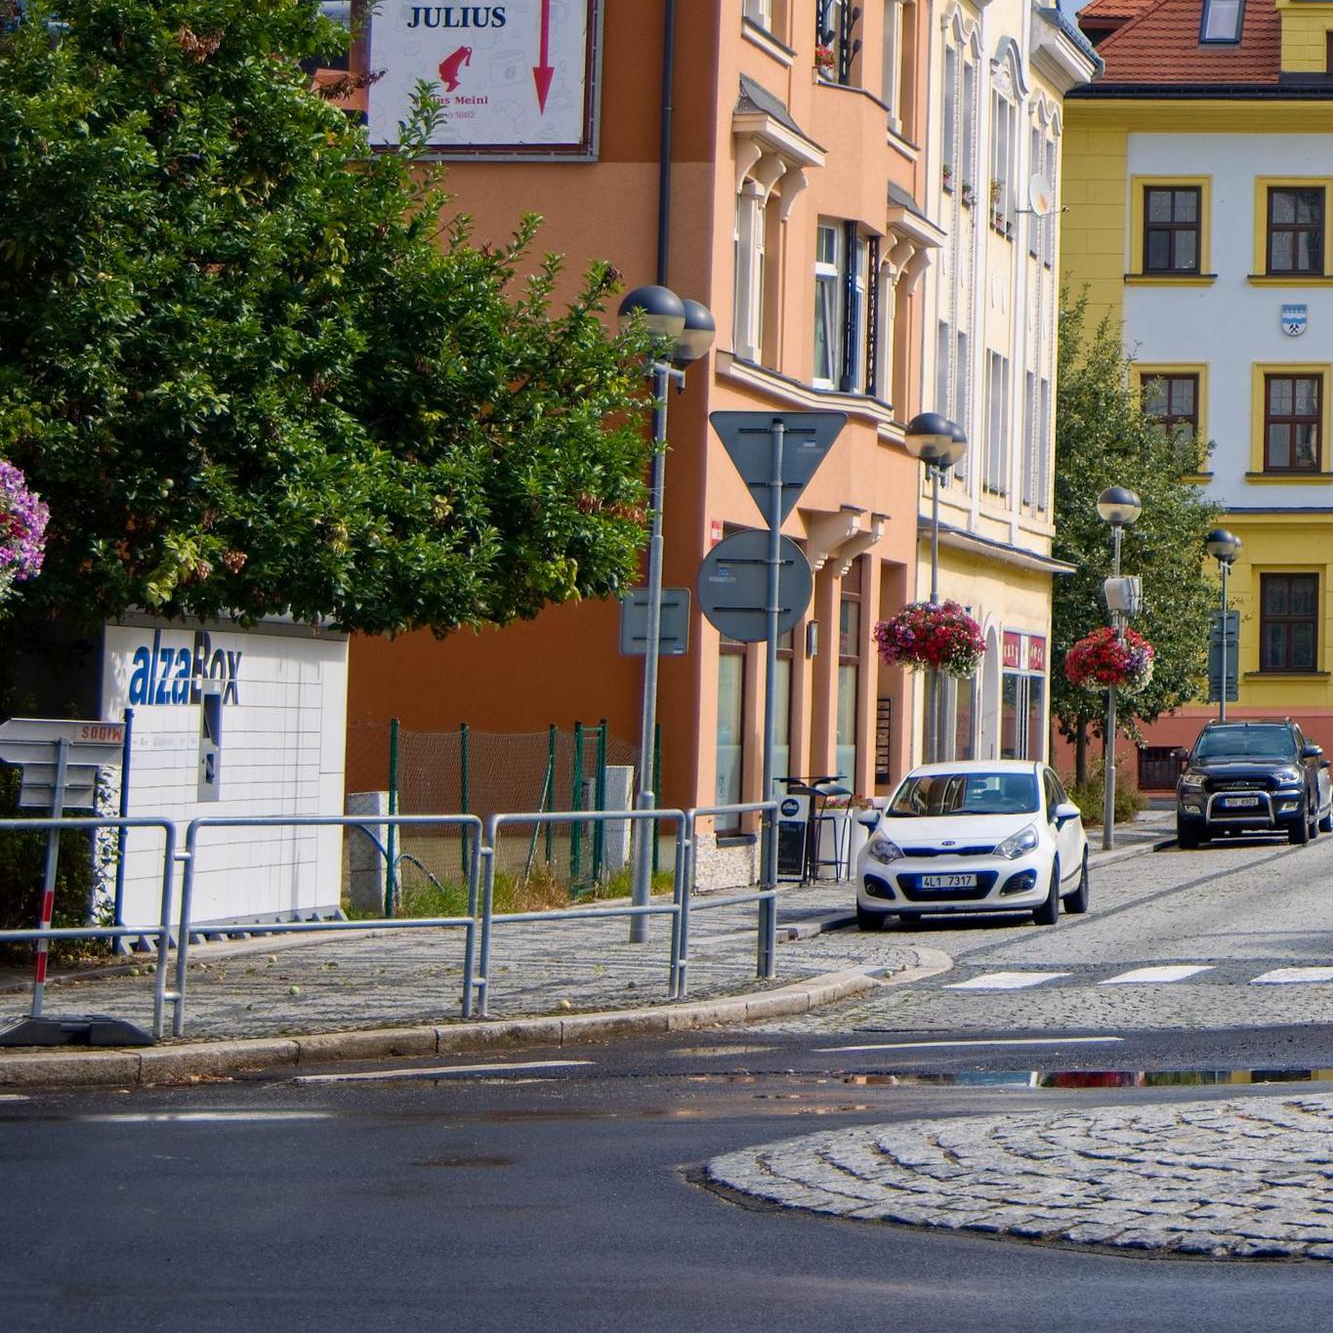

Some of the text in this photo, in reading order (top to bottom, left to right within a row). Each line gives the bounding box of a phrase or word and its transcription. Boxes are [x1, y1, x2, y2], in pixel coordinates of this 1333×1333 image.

[407, 6, 506, 28] JULIUS
[455, 95, 488, 105] Meinl
[129, 628, 243, 706] alzaBox
[924, 875, 972, 887] 4L1 7317
